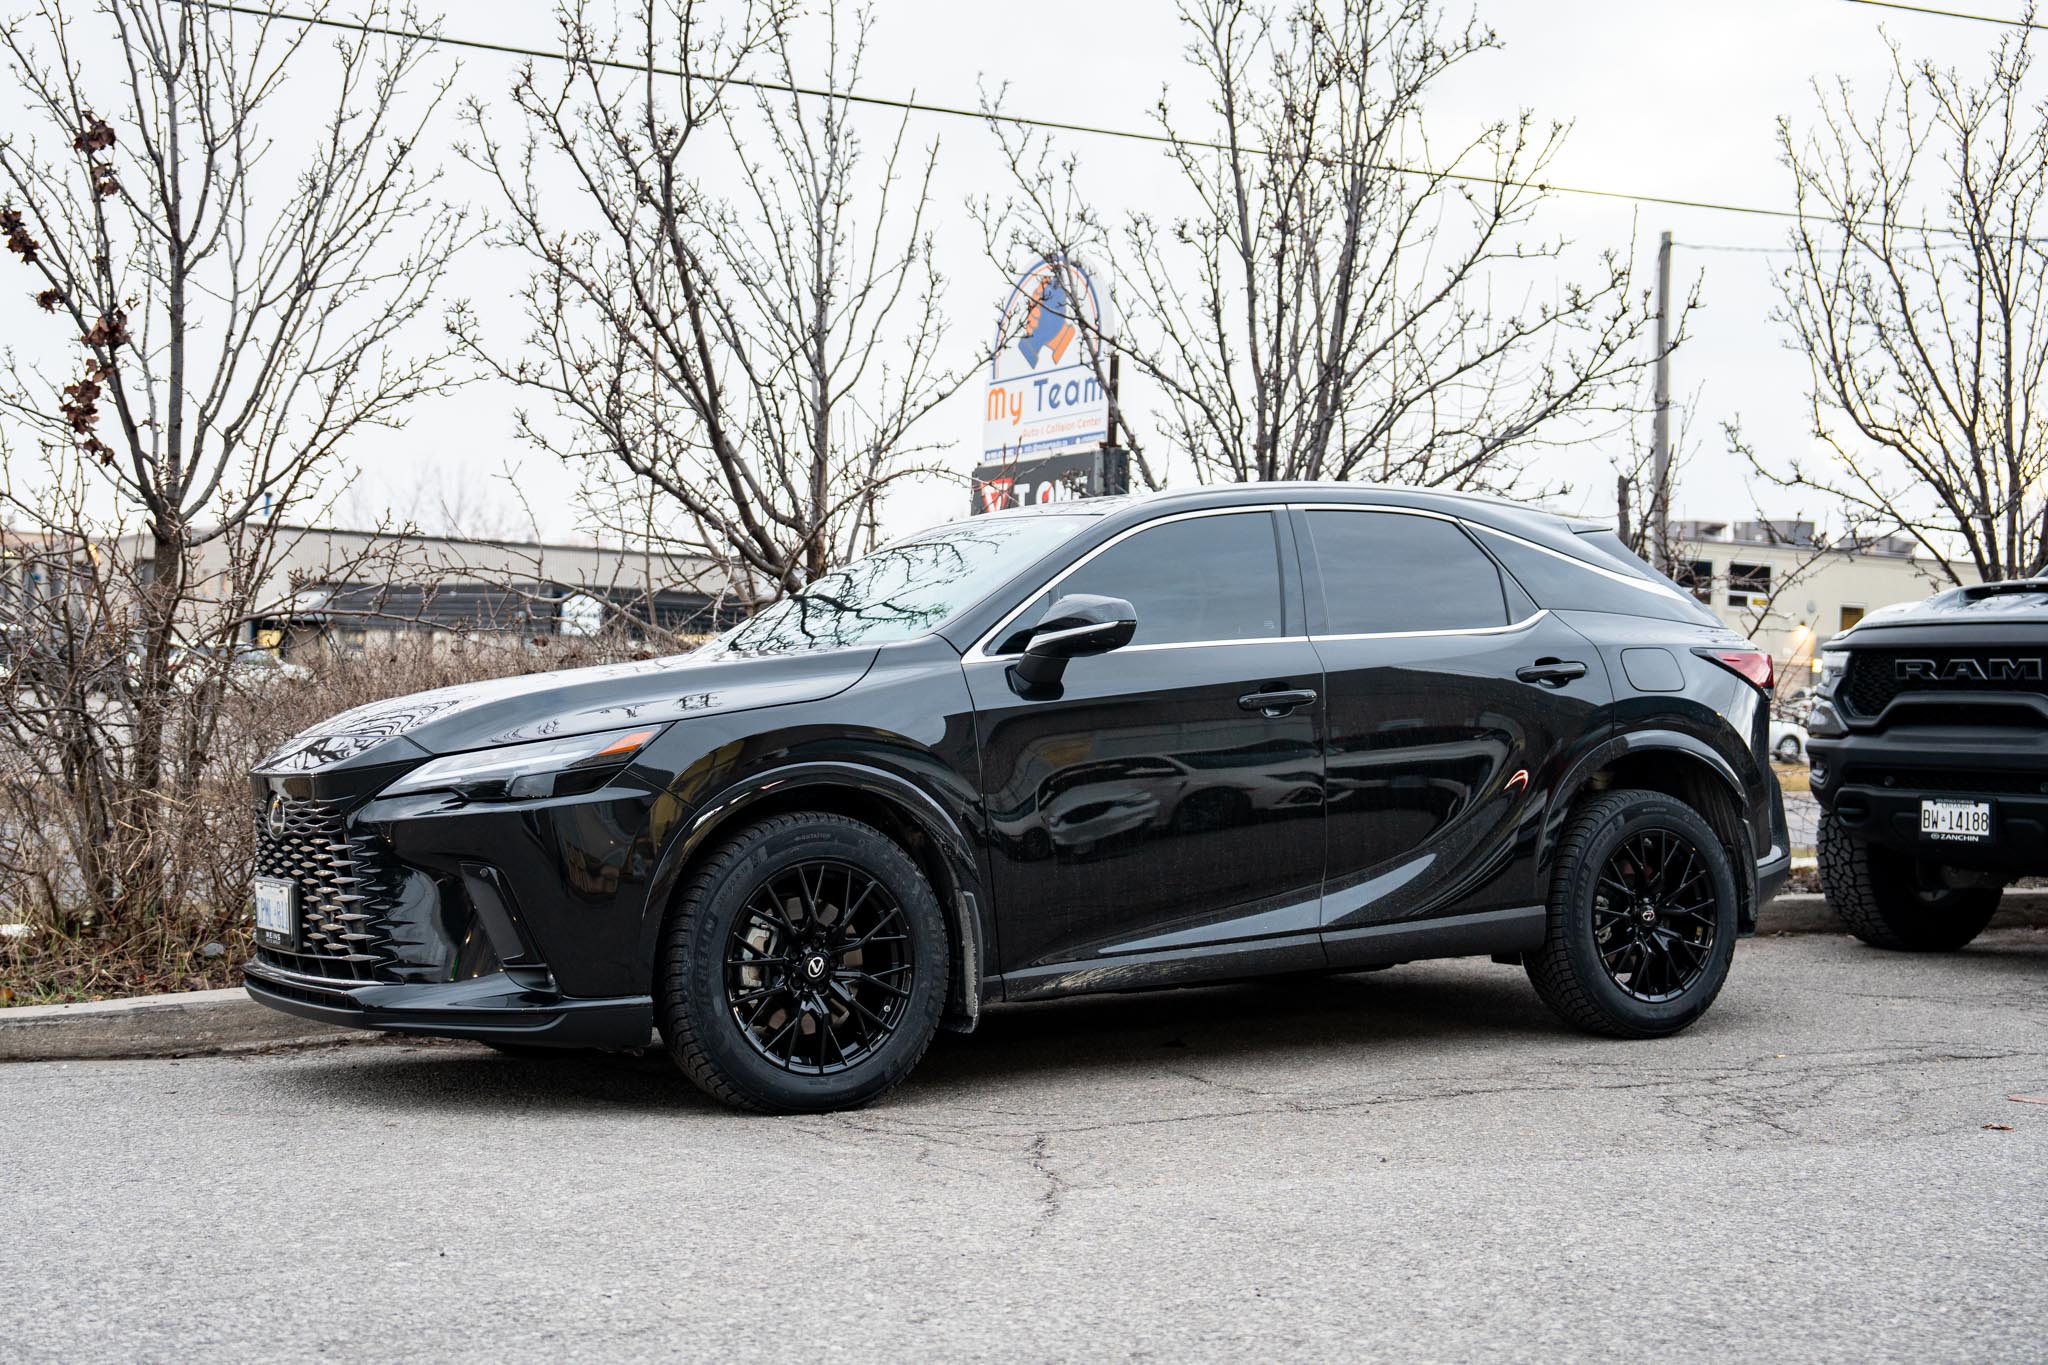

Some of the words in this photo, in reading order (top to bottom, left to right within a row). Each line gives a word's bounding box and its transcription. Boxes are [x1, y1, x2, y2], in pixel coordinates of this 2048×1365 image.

[987, 387, 1023, 426] My
[1033, 376, 1104, 412] Team
[1895, 658, 2042, 680] RAM
[1940, 833, 1979, 842] ZANCHIN
